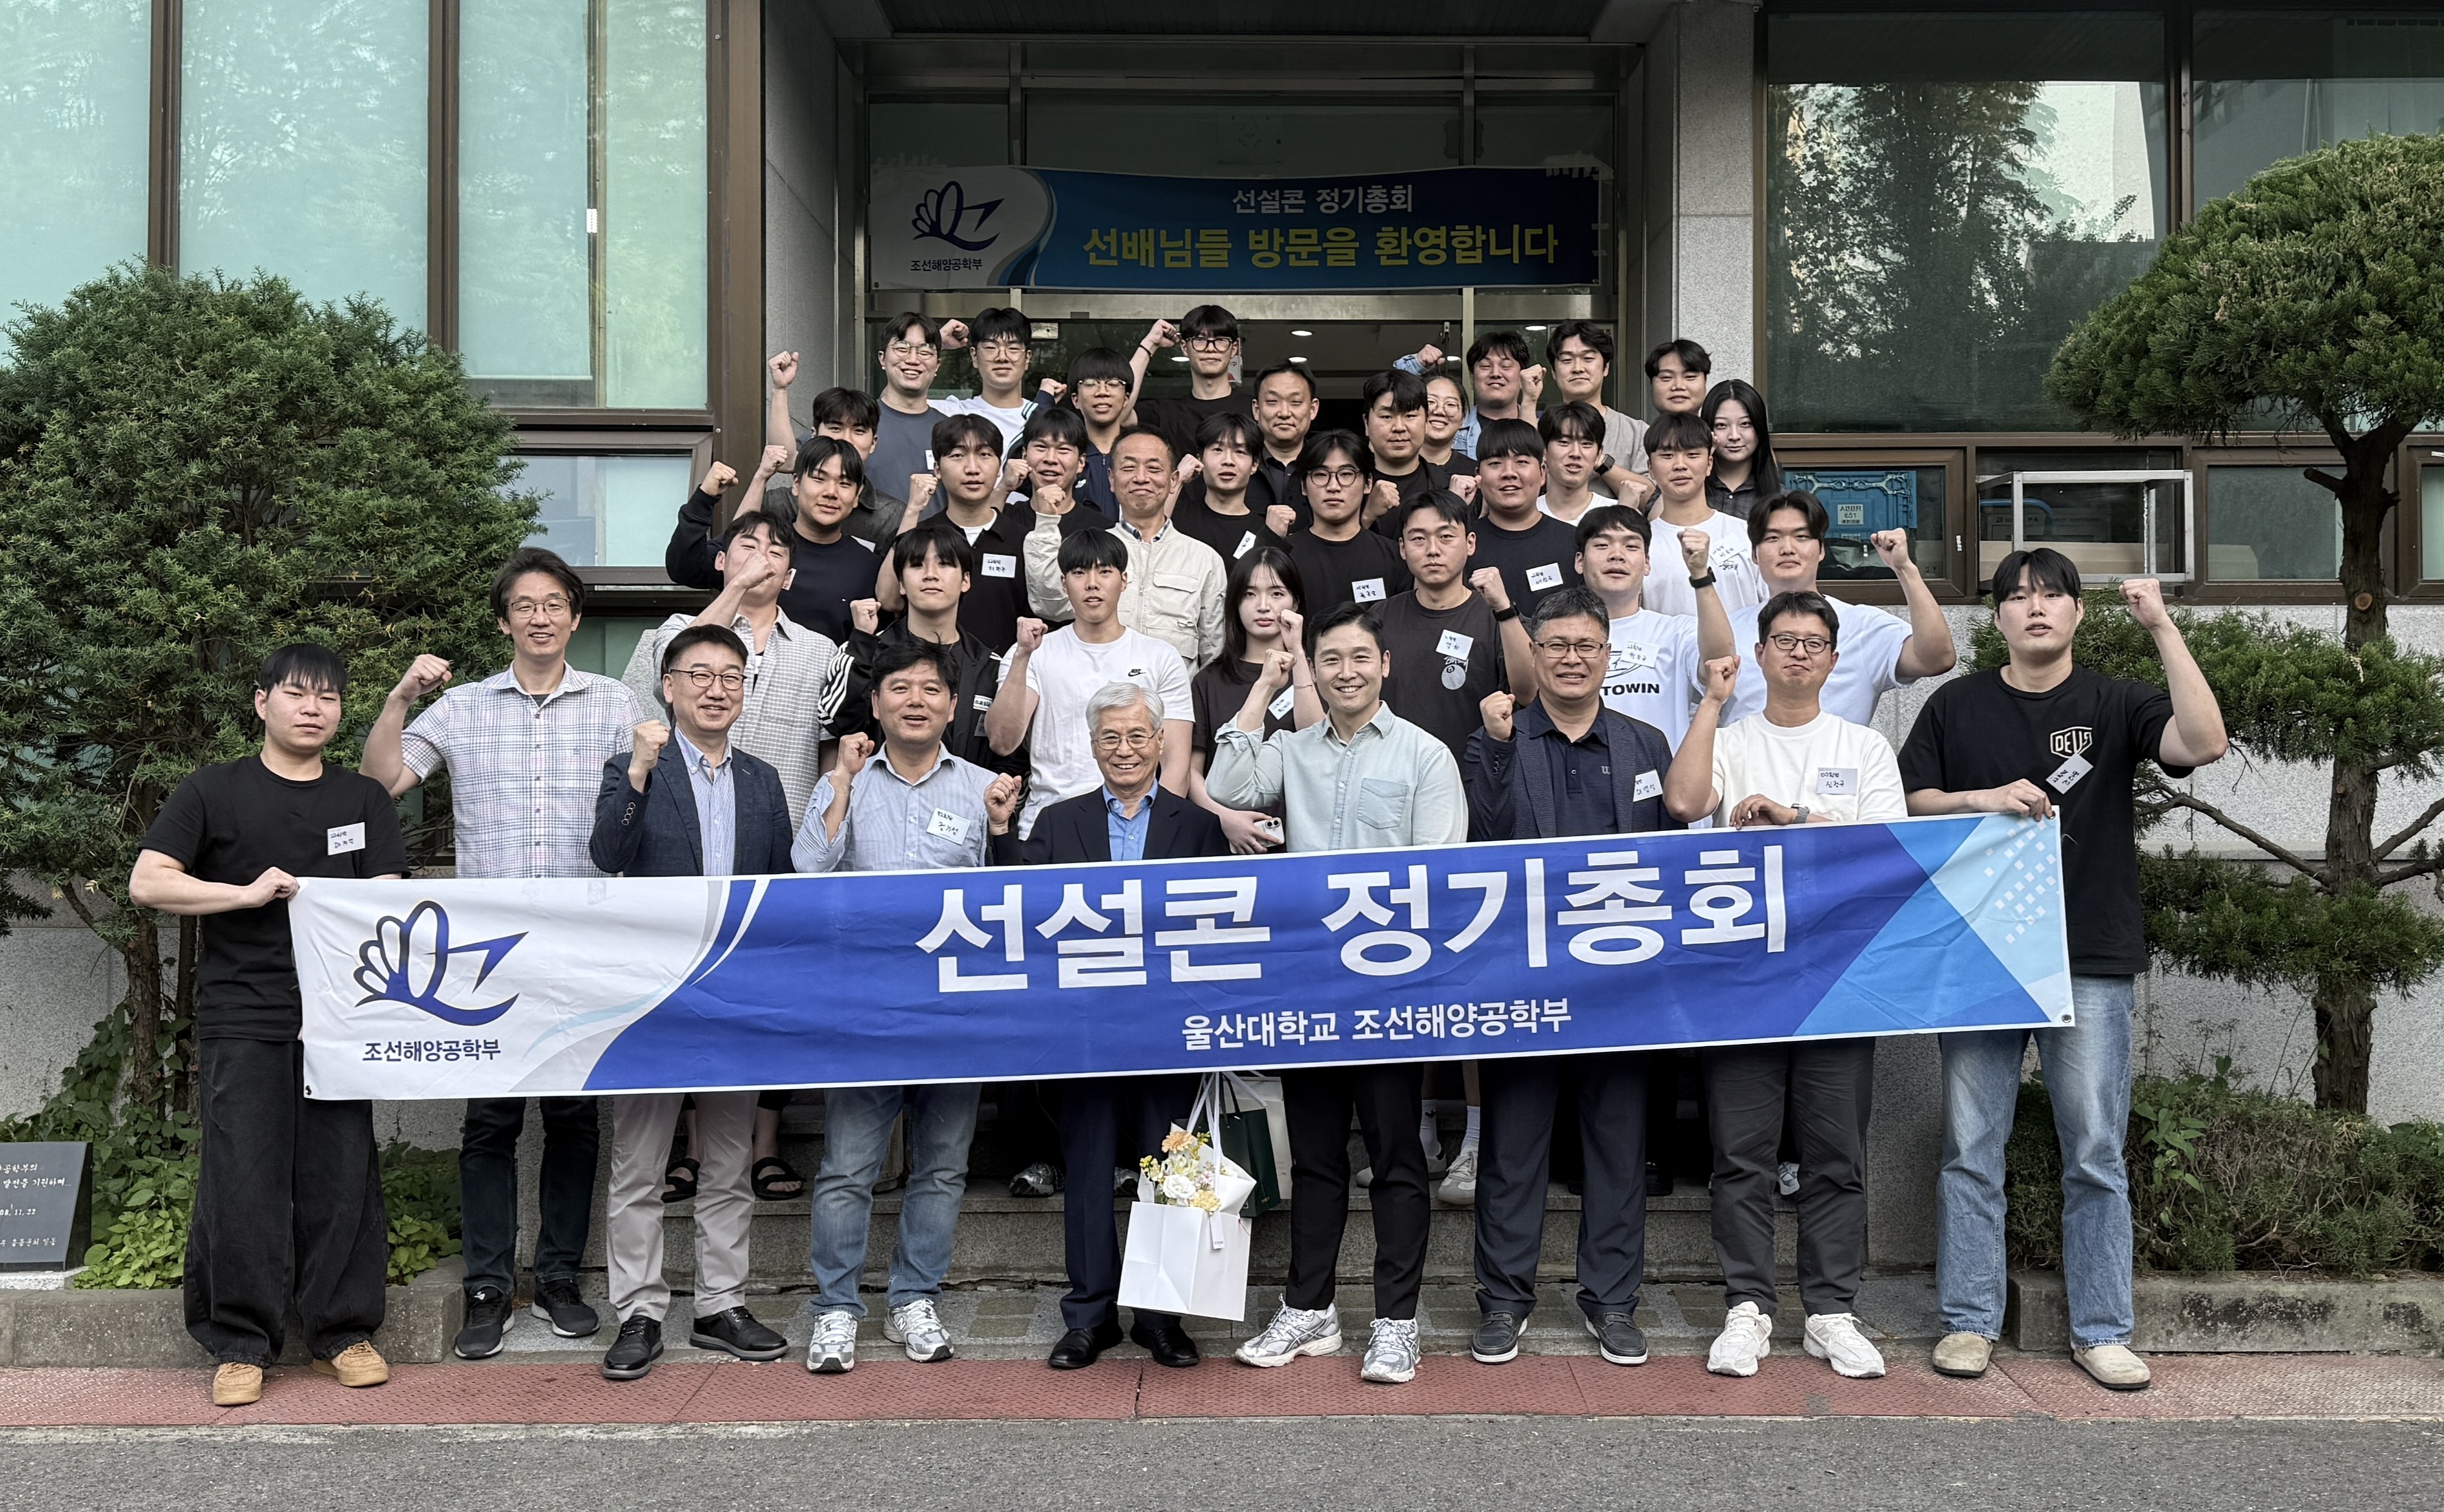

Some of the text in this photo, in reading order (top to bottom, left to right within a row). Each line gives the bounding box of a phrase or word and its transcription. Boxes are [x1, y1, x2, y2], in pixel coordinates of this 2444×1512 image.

[1232, 184, 1414, 214] 선설콘 정기총회
[1084, 224, 1559, 268] 선배님들 방문을 환영합니다
[910, 258, 982, 272] 조선해양공학부
[1601, 683, 1660, 696] TOWIN
[915, 845, 1786, 993] 선설콘 정기총회
[1181, 998, 1572, 1050] 울산대학교 조선해양공학부
[362, 1038, 502, 1063] 조선해양공학부
